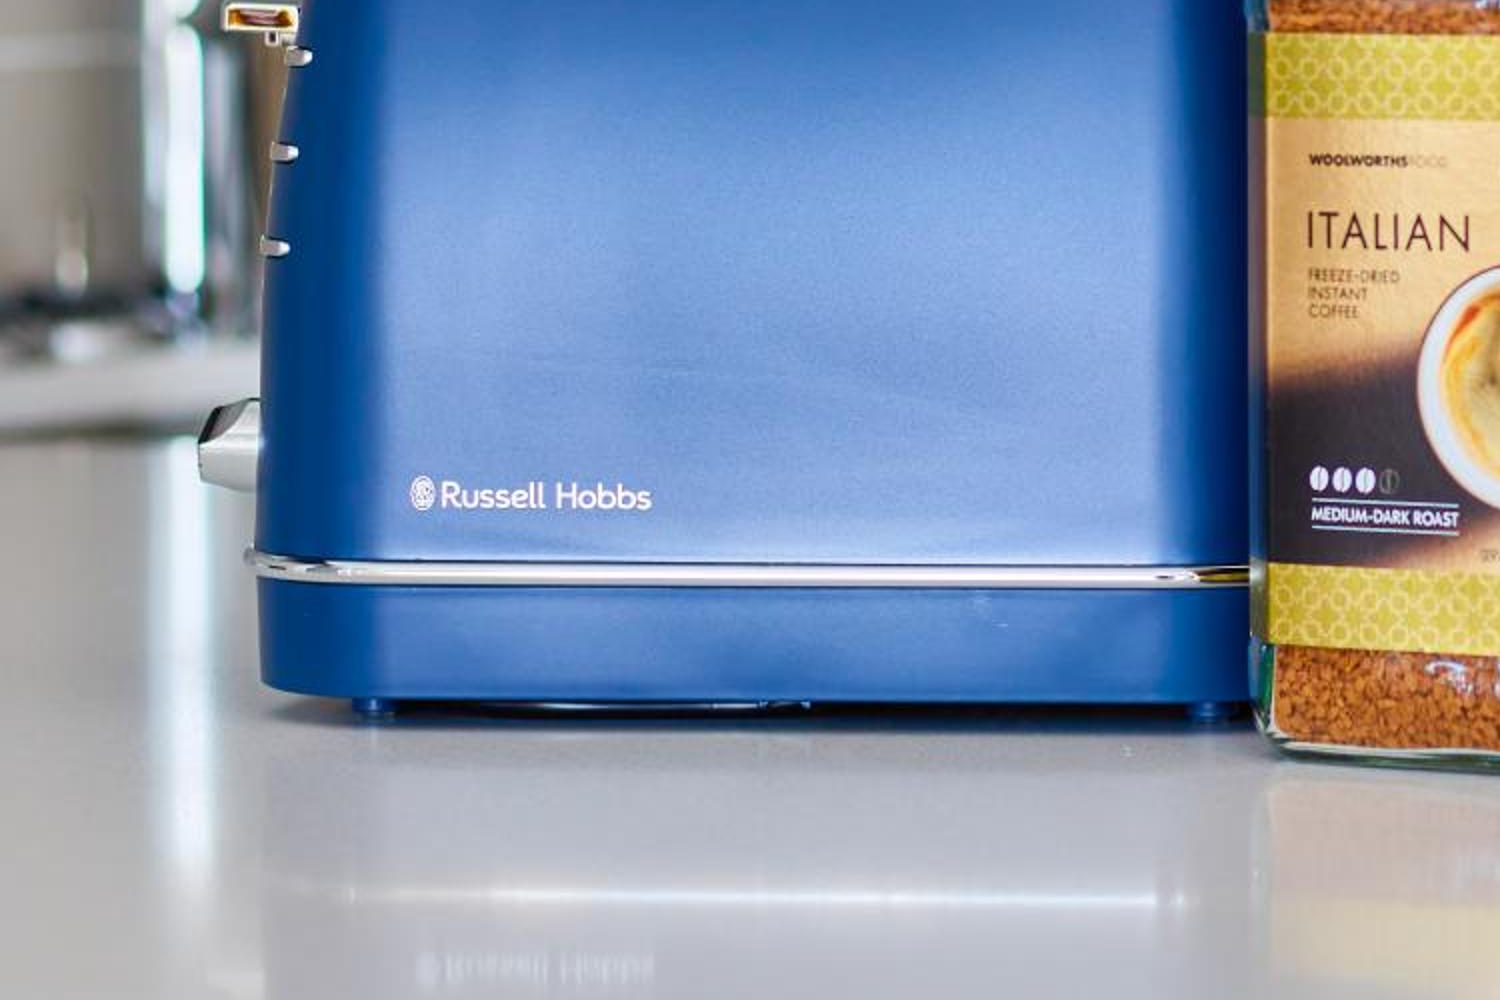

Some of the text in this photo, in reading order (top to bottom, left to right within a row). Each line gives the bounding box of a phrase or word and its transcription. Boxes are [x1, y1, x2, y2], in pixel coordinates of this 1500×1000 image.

[1307, 210, 1470, 252] ITALIAN
[1307, 267, 1400, 284] FREEZE-DRIED
[1307, 286, 1368, 301] INSTANT
[1308, 303, 1361, 319] COFFEE
[440, 480, 653, 511] Russell Hobbs
[1311, 505, 1460, 528] MEDIUM-DARK ROAST
